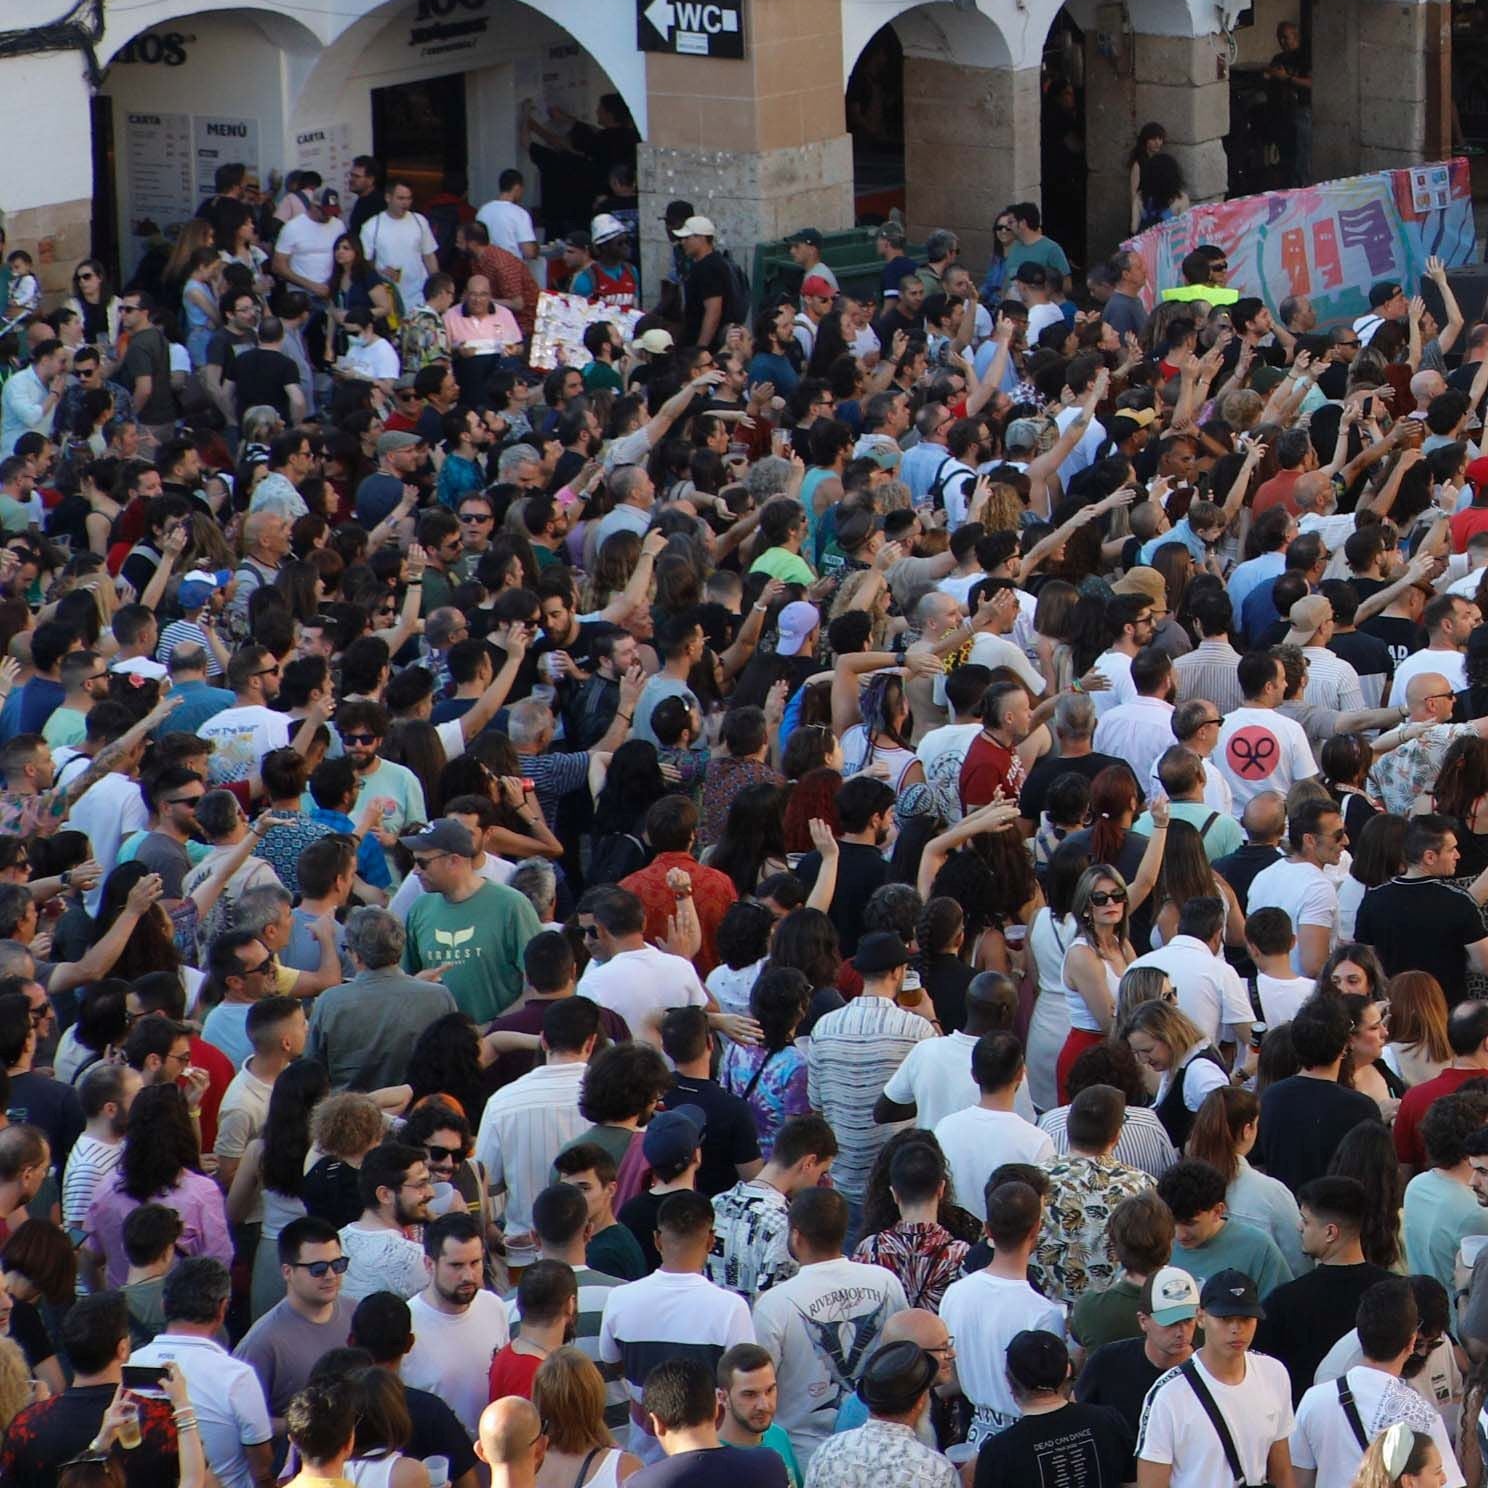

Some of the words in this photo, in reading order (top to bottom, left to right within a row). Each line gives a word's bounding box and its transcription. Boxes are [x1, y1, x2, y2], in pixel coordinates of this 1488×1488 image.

[676, 1, 722, 34] WC
[808, 1286, 881, 1317] RIVERMOUTH
[1033, 1440, 1054, 1452] DEAD
[1054, 1436, 1070, 1446] CAN
[1069, 1427, 1093, 1442] DANCE
